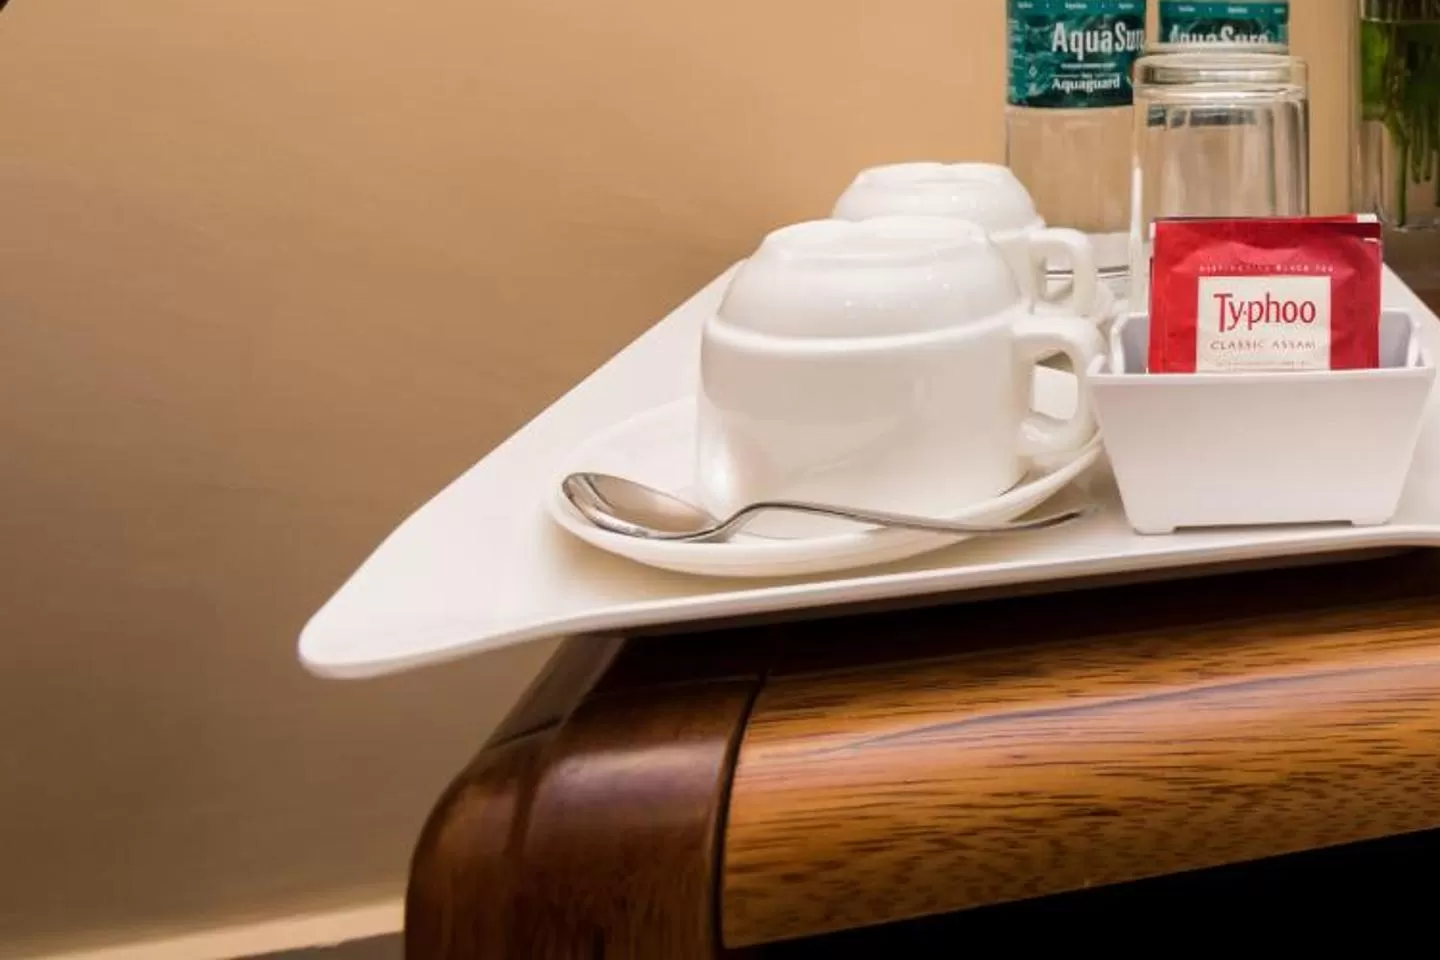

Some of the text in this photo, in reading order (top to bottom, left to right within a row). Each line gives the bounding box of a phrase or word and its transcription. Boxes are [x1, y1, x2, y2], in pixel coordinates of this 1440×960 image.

[1051, 75, 1120, 94] Aquaguard
[1209, 339, 1317, 351] CLASSIC ASSAM
